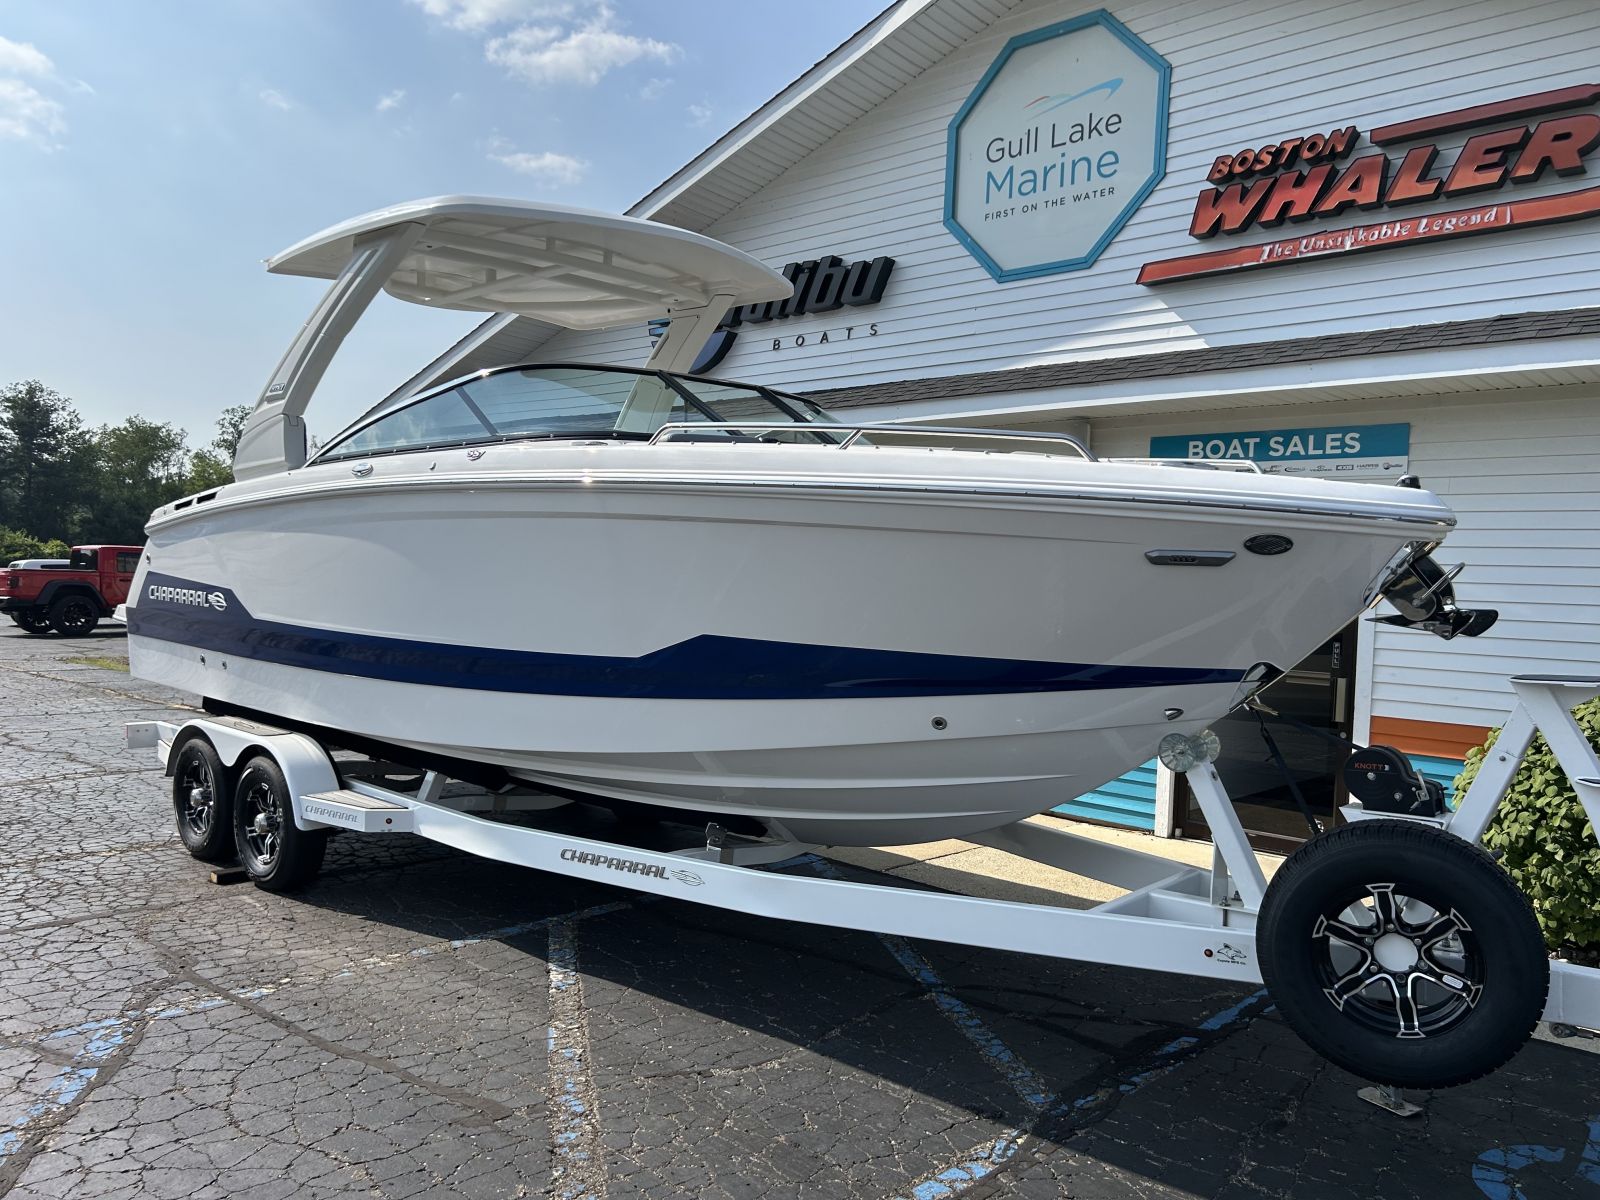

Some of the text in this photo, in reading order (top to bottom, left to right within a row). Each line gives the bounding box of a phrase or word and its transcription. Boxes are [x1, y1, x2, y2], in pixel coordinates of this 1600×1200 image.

[986, 112, 1122, 164] Gull Lake
[1206, 126, 1360, 183] BOSTON
[985, 150, 1120, 204] Marine
[1189, 114, 1600, 240] WHALER
[984, 186, 1115, 222] FIRST ON THE WATER
[1260, 242, 1293, 261] The
[1417, 207, 1497, 234] Legend
[718, 255, 896, 328] libu
[772, 324, 878, 351] BOATS
[1187, 432, 1361, 459] BOAT SALES
[148, 585, 209, 607] CHAPARRAL
[305, 804, 359, 823] CHAPARRAL
[560, 848, 670, 881] CHAPARRAL
